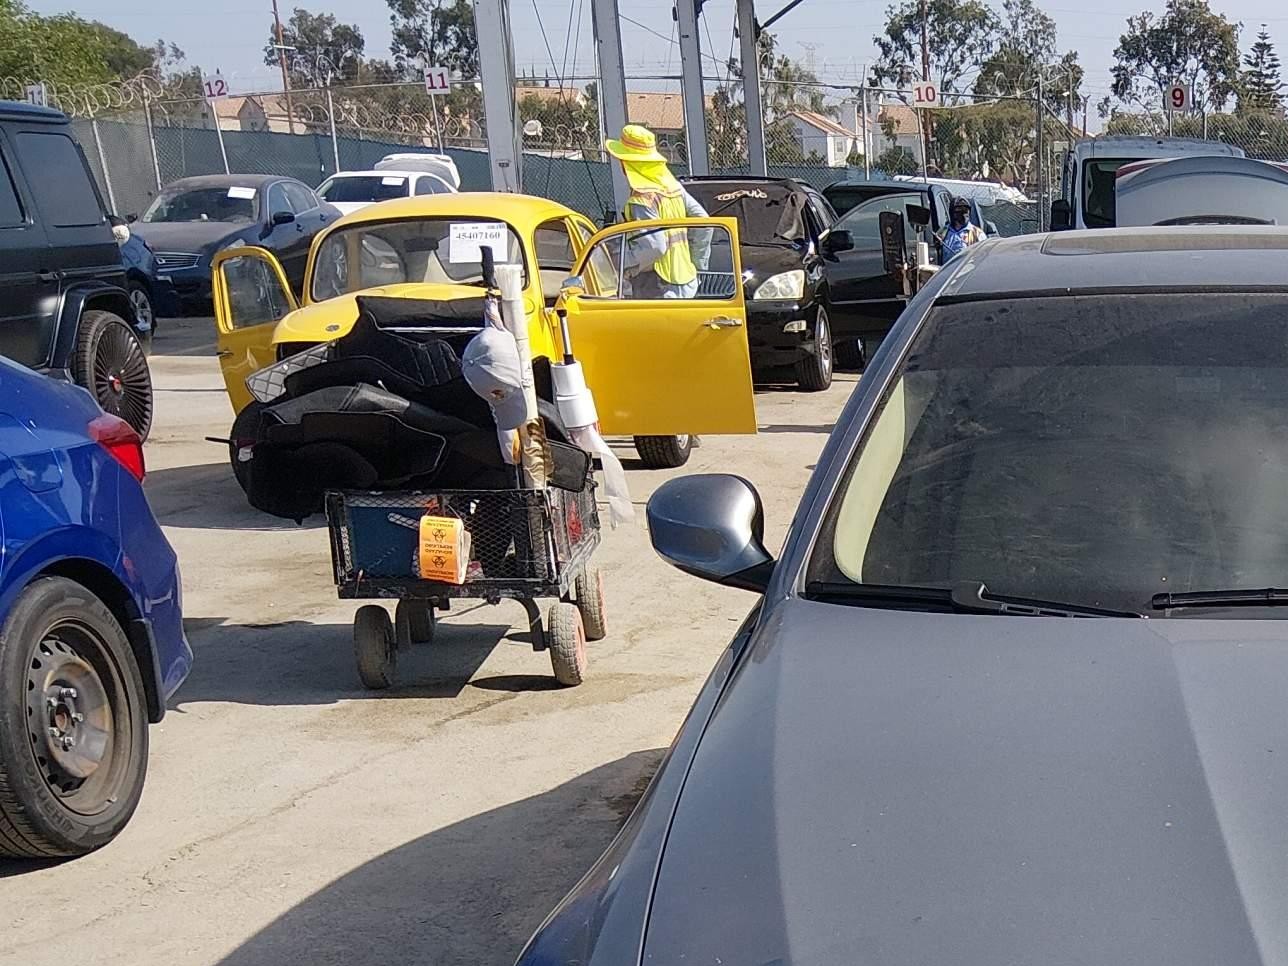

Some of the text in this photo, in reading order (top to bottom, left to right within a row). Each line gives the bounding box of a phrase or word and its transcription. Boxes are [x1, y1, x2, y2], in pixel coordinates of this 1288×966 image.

[205, 79, 226, 98] 12
[426, 72, 448, 90] 11
[914, 86, 936, 103] 10
[1171, 87, 1185, 107] 9
[455, 231, 501, 240] 45407160
